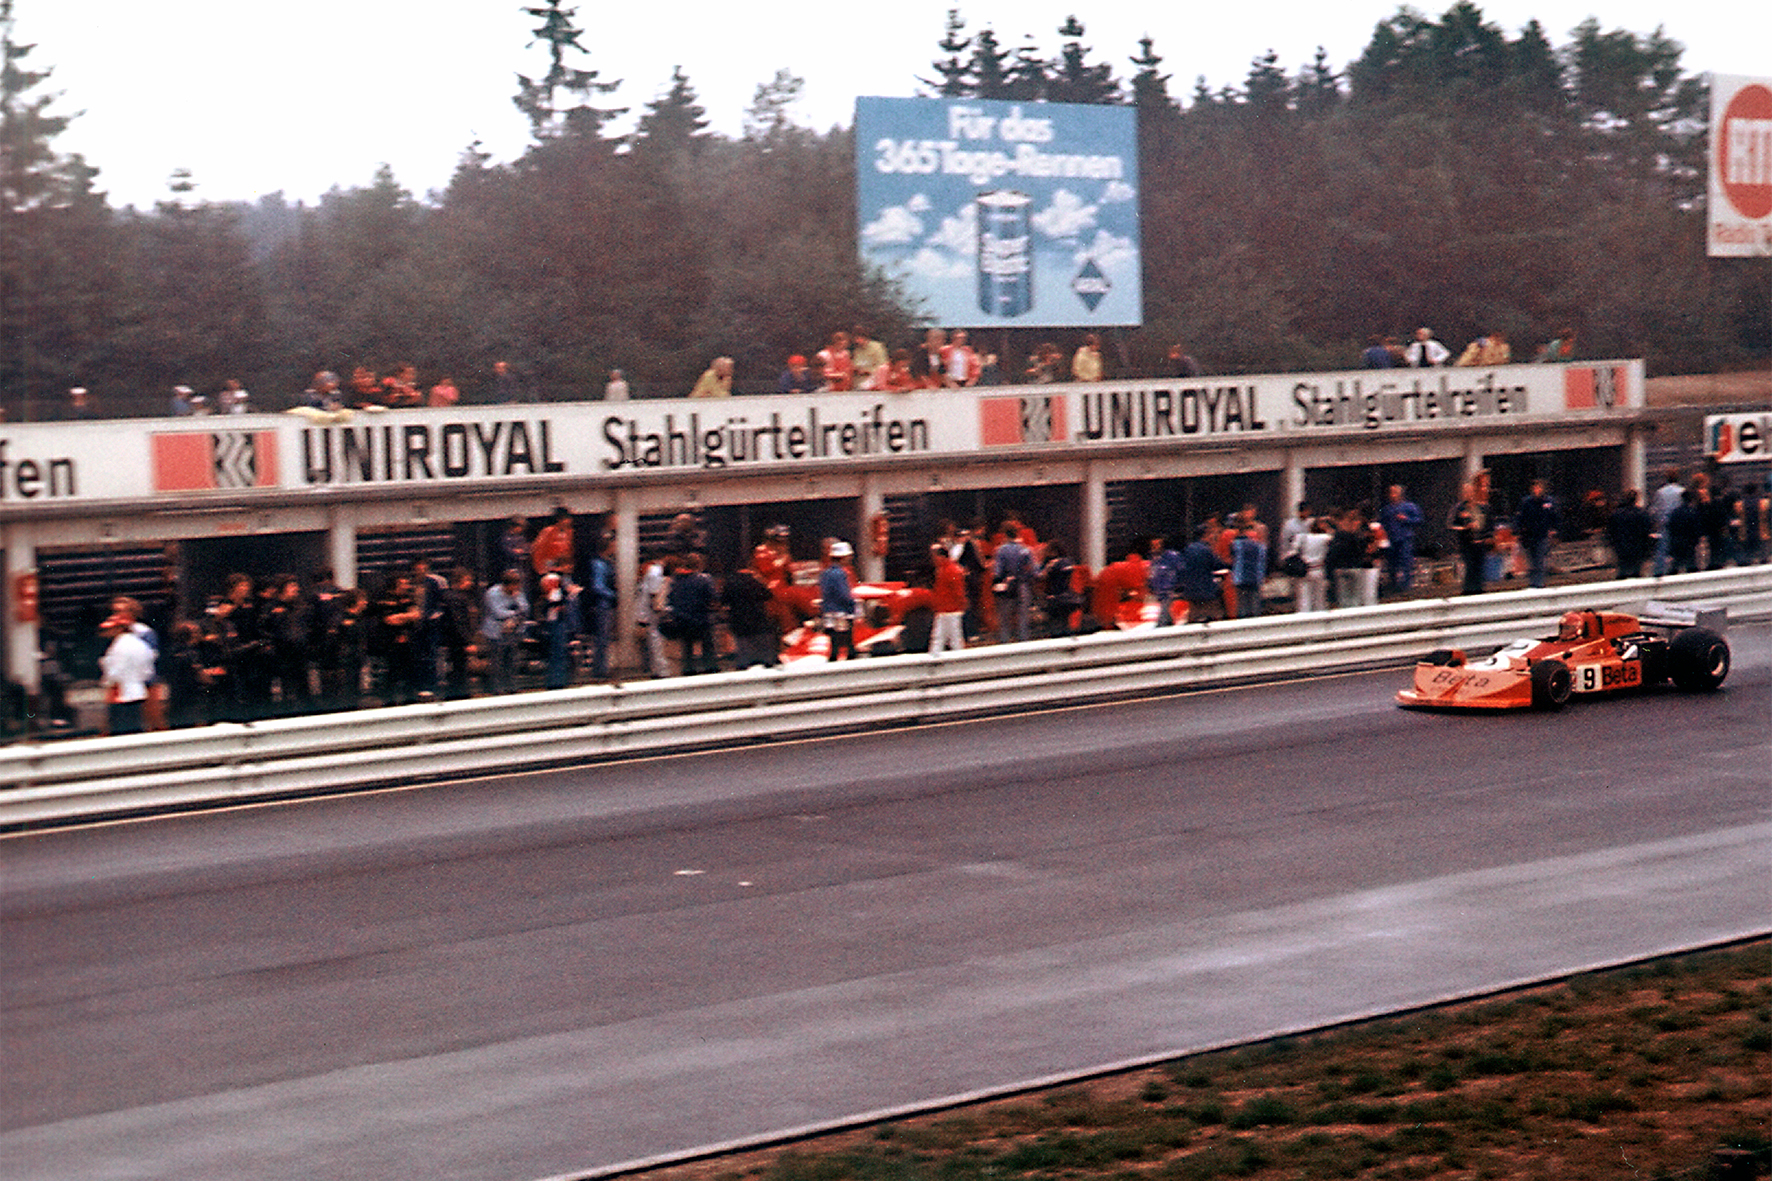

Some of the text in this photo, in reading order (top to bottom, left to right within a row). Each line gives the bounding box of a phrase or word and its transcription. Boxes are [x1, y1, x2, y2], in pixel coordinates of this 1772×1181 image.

[950, 105, 1055, 142] Für das
[1079, 373, 1527, 440] UNIROYAL Stahlgürtelreifen
[303, 404, 927, 483] UNIROYAL Stahlgürtelreifen
[1583, 664, 1639, 691] 9 Beta
